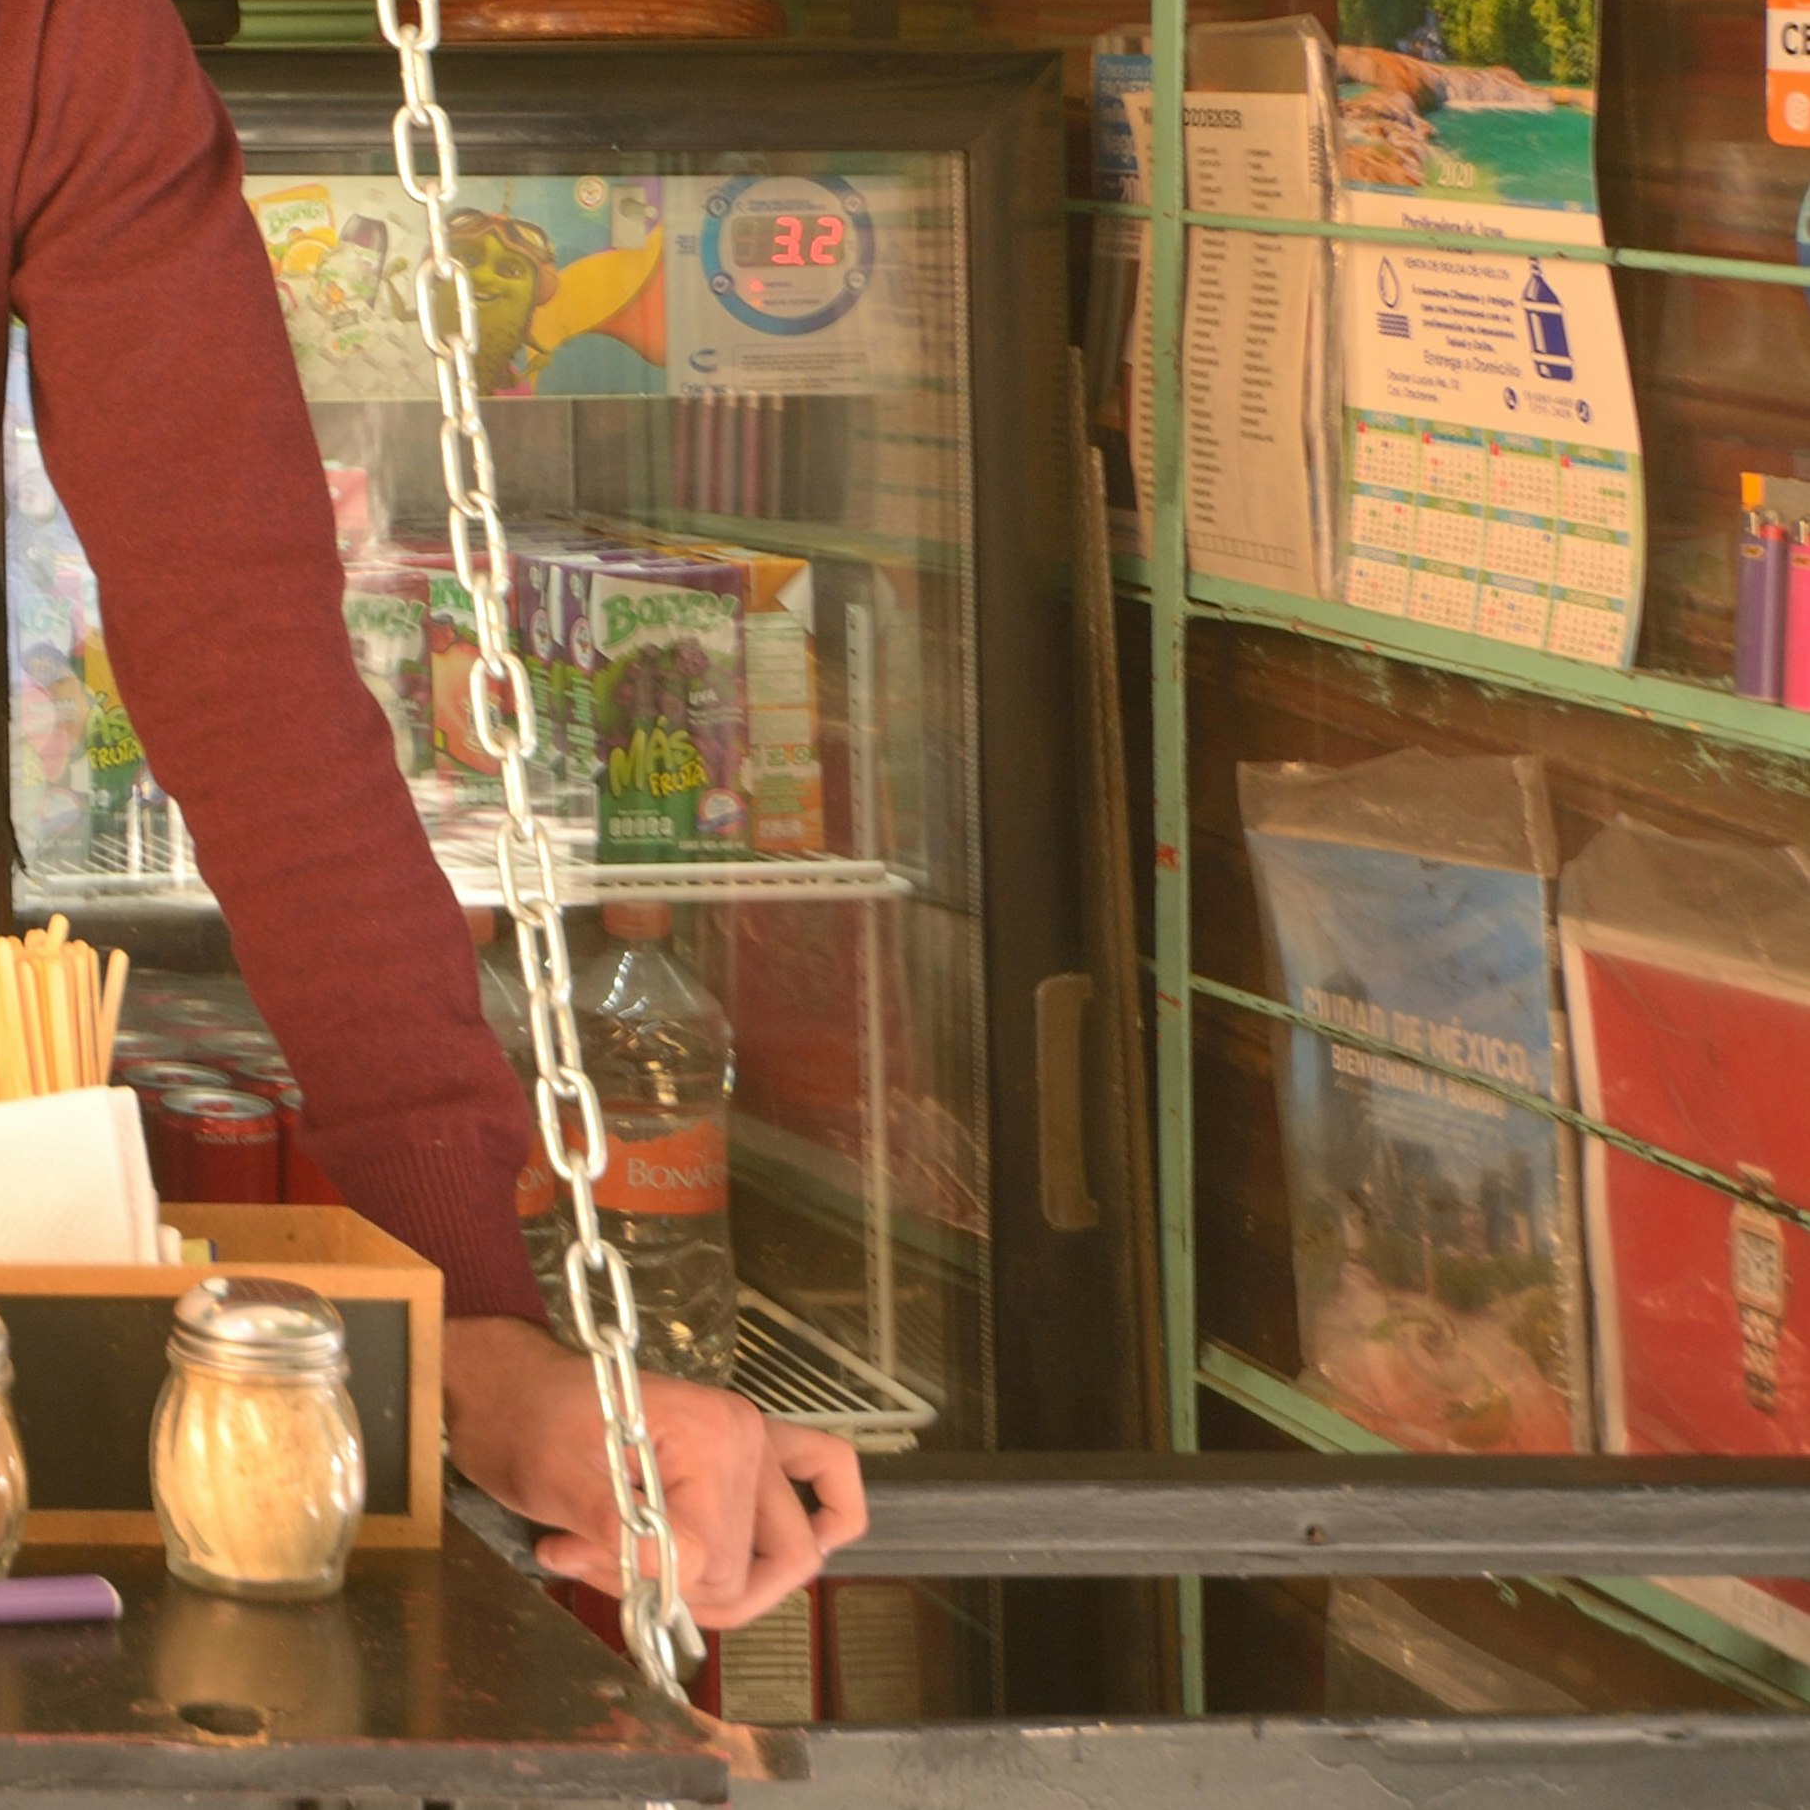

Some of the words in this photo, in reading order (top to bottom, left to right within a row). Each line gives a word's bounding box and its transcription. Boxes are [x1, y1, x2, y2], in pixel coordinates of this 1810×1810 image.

[1439, 160, 1476, 188] 2020
[86, 691, 130, 747] ÁS
[608, 714, 704, 801] MÁS
[647, 760, 710, 798] FRUTA
